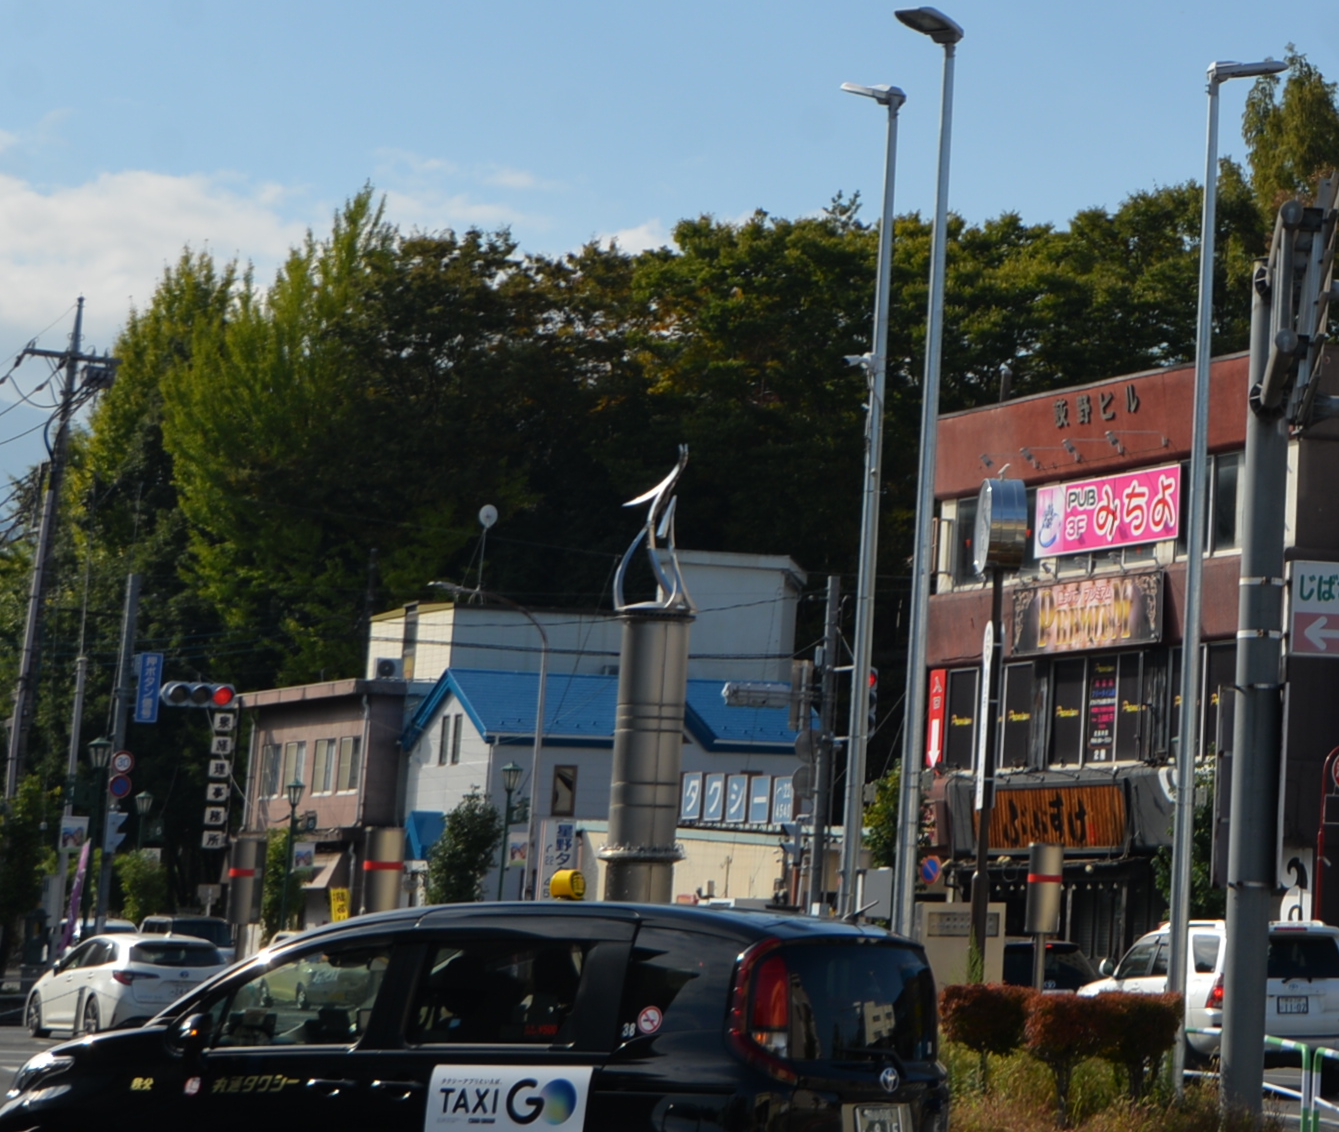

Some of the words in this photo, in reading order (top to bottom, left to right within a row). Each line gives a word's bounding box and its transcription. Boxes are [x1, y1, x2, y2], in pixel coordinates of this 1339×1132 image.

[1067, 488, 1097, 510] PUB
[1094, 474, 1176, 541] みちよ
[1066, 515, 1087, 541] 3F
[932, 677, 942, 710] 入口
[117, 757, 129, 767] 30
[686, 779, 767, 814] タクシー
[555, 824, 574, 872] 星野タ
[622, 1023, 636, 1037] 38
[440, 1088, 499, 1114] TAXI
